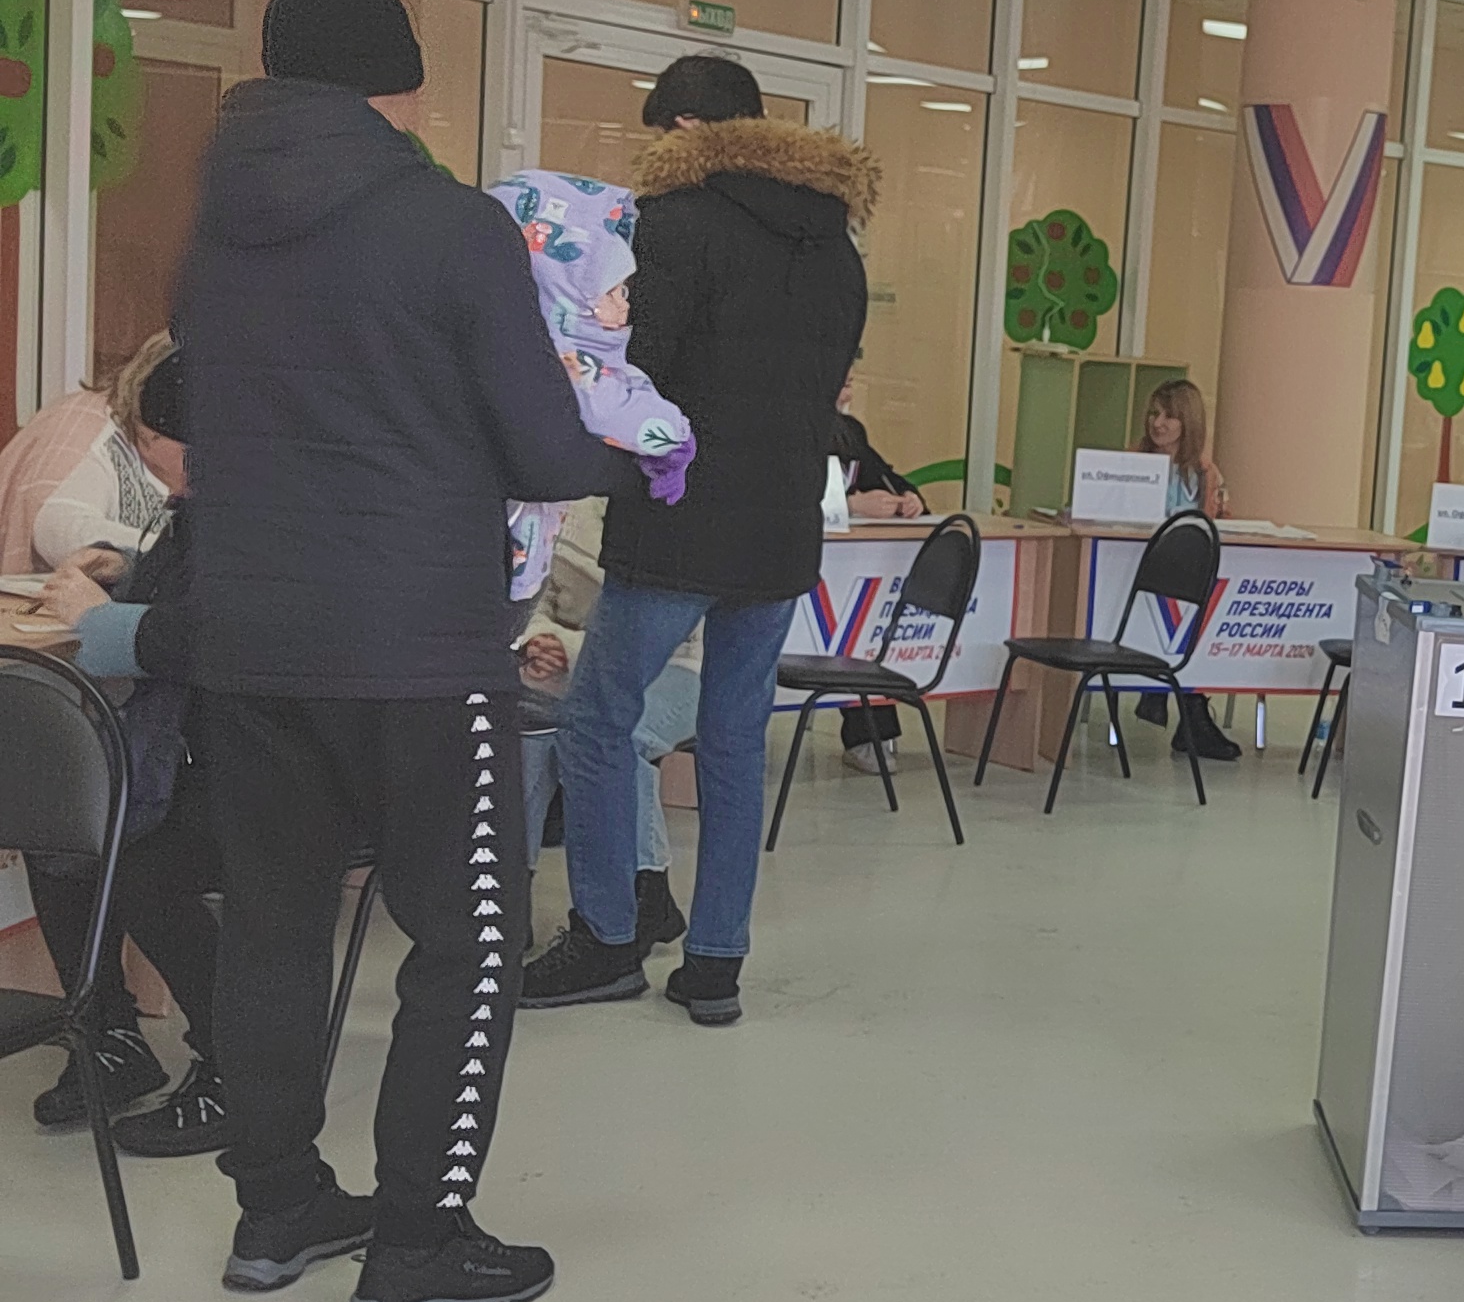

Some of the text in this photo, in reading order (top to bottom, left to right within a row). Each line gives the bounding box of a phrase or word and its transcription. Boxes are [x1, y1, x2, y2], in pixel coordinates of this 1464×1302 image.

[1237, 578, 1315, 597] ВЫБОРЫ
[1226, 600, 1334, 619] ПРЕЗИДЕНТА
[870, 622, 936, 643] РССИИ
[1216, 622, 1288, 639] РОССИИ
[1242, 643, 1284, 659] МАРТА
